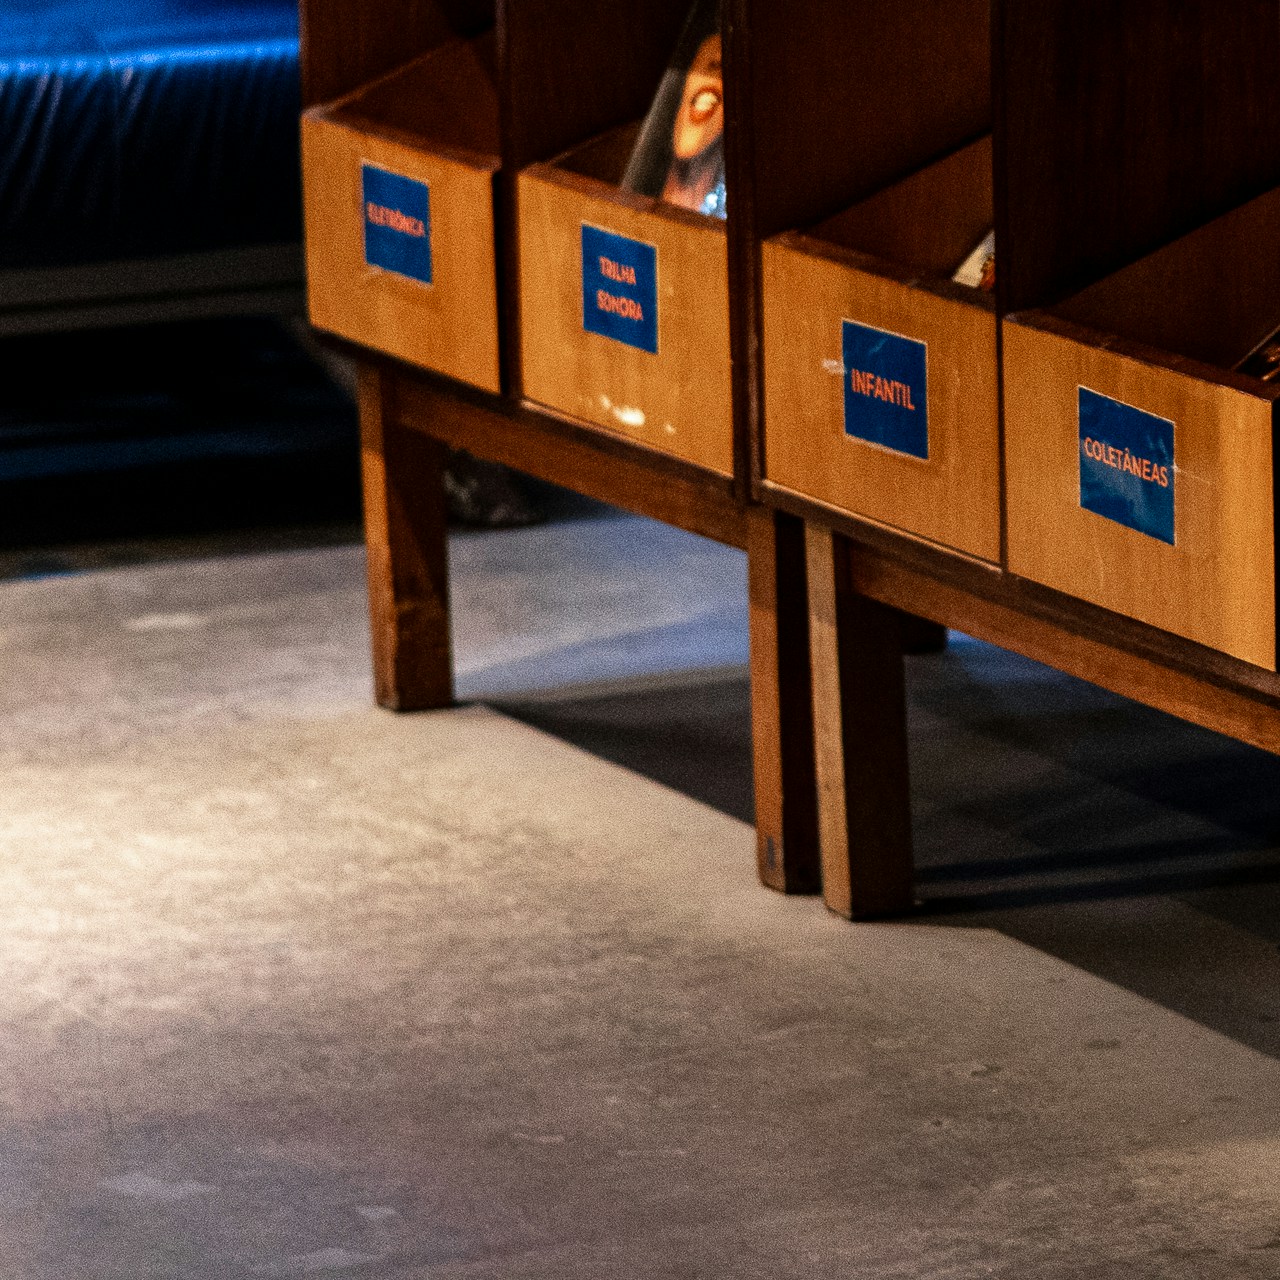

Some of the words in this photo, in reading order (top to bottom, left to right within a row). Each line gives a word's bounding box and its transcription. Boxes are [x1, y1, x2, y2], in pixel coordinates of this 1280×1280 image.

[599, 256, 637, 285] TRILHA
[596, 289, 644, 322] SONORA
[850, 368, 916, 411] INFANTIL
[1084, 436, 1169, 488] COLETÂNEAS
